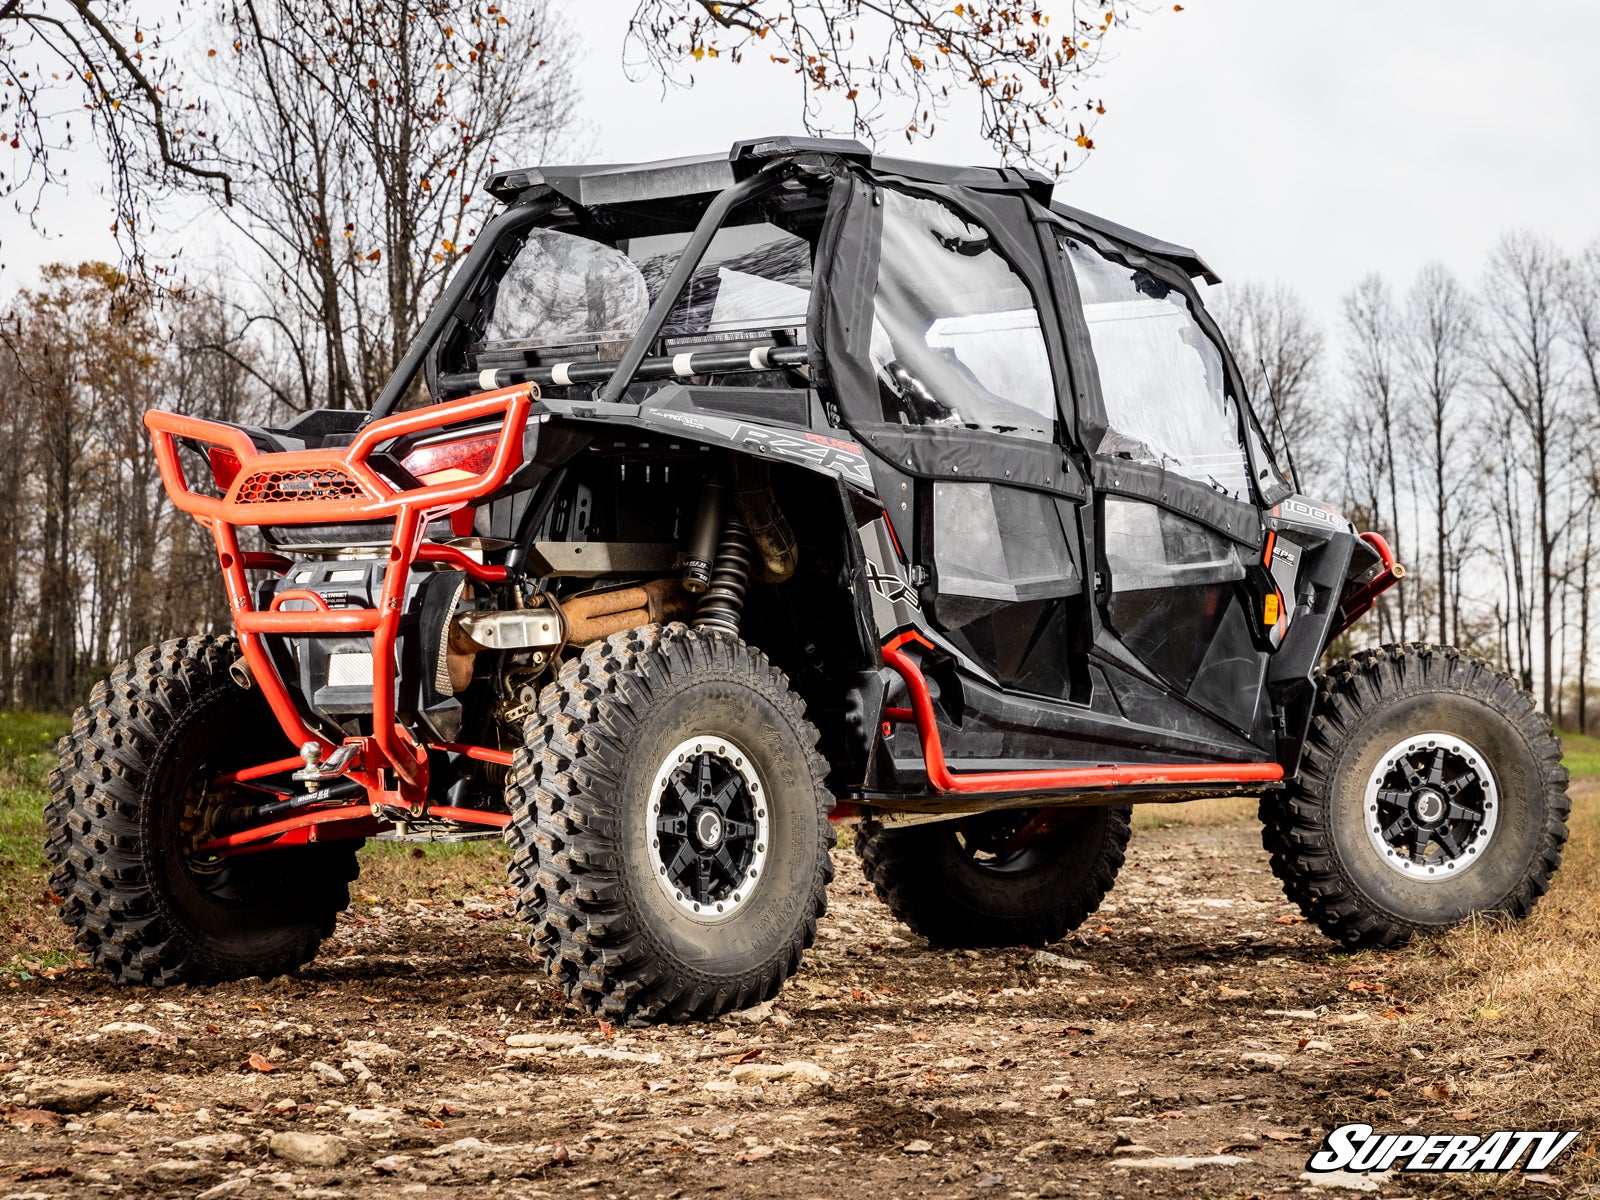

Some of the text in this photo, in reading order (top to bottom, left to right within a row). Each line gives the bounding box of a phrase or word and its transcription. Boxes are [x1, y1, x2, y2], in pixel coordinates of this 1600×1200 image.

[730, 423, 870, 482] RZR
[804, 432, 861, 456] POLARIS
[1284, 498, 1343, 530] 1000
[1273, 546, 1296, 562] EPS
[297, 792, 318, 803] RHINO
